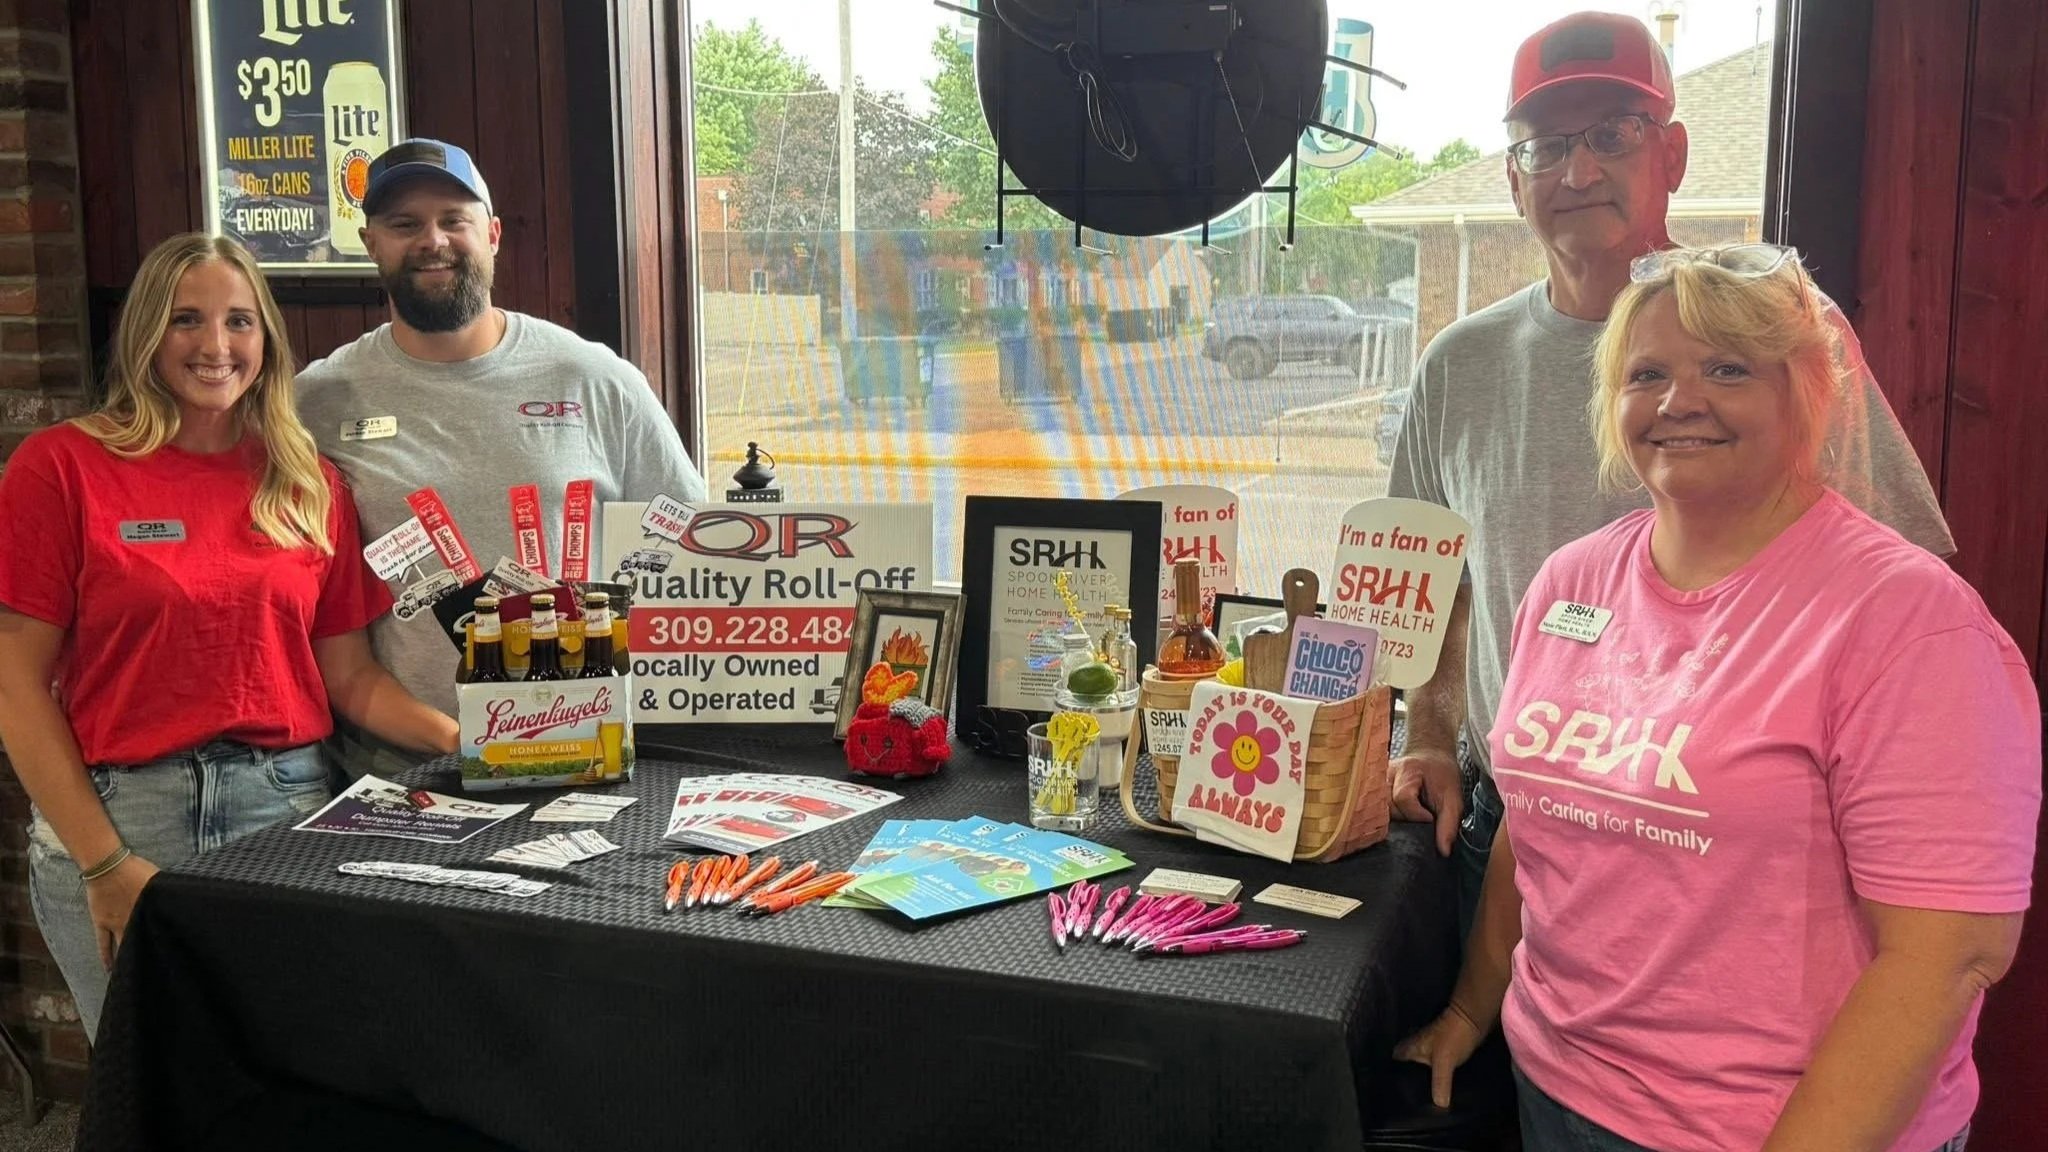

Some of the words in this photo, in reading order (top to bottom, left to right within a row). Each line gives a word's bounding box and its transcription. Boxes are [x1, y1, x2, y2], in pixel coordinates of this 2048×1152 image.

[331, 105, 380, 146] Lite
[228, 137, 280, 160] MILLER
[283, 135, 315, 159] LITE
[272, 172, 311, 195] CANS
[237, 208, 314, 232] EVERYDAY!
[517, 401, 582, 417] QR
[1174, 506, 1209, 522] fan
[1216, 503, 1235, 522] of
[366, 538, 393, 559] QUALITY
[437, 528, 463, 561] CHOMPS
[522, 532, 538, 566] CHOMPS
[569, 524, 582, 558] CHOMPS
[677, 509, 859, 561] QR
[1340, 524, 1366, 547] I'm
[1371, 532, 1384, 548] a
[1390, 527, 1428, 552] fan
[1436, 534, 1465, 557] of
[1007, 587, 1046, 599] HOME
[1035, 608, 1062, 617] Caring
[1331, 605, 1365, 622] HOME
[1370, 610, 1434, 633] HEALTH
[632, 655, 715, 680] ocally
[724, 654, 820, 677] Owned
[1295, 639, 1364, 674] CHOCO
[474, 686, 612, 745] Leinenkugel's
[638, 688, 659, 711] &
[668, 688, 796, 715] Operated
[509, 745, 547, 754] HONEY
[550, 744, 582, 752] WEISS
[1189, 695, 1224, 755] TODAY
[1229, 691, 1248, 707] IS
[1252, 693, 1296, 738] YOUR
[1289, 740, 1302, 784] DAY
[1188, 784, 1286, 833] ALWAYS
[1539, 796, 1598, 830] Caring
[1602, 810, 1629, 832] for
[1635, 819, 1713, 855] Family
